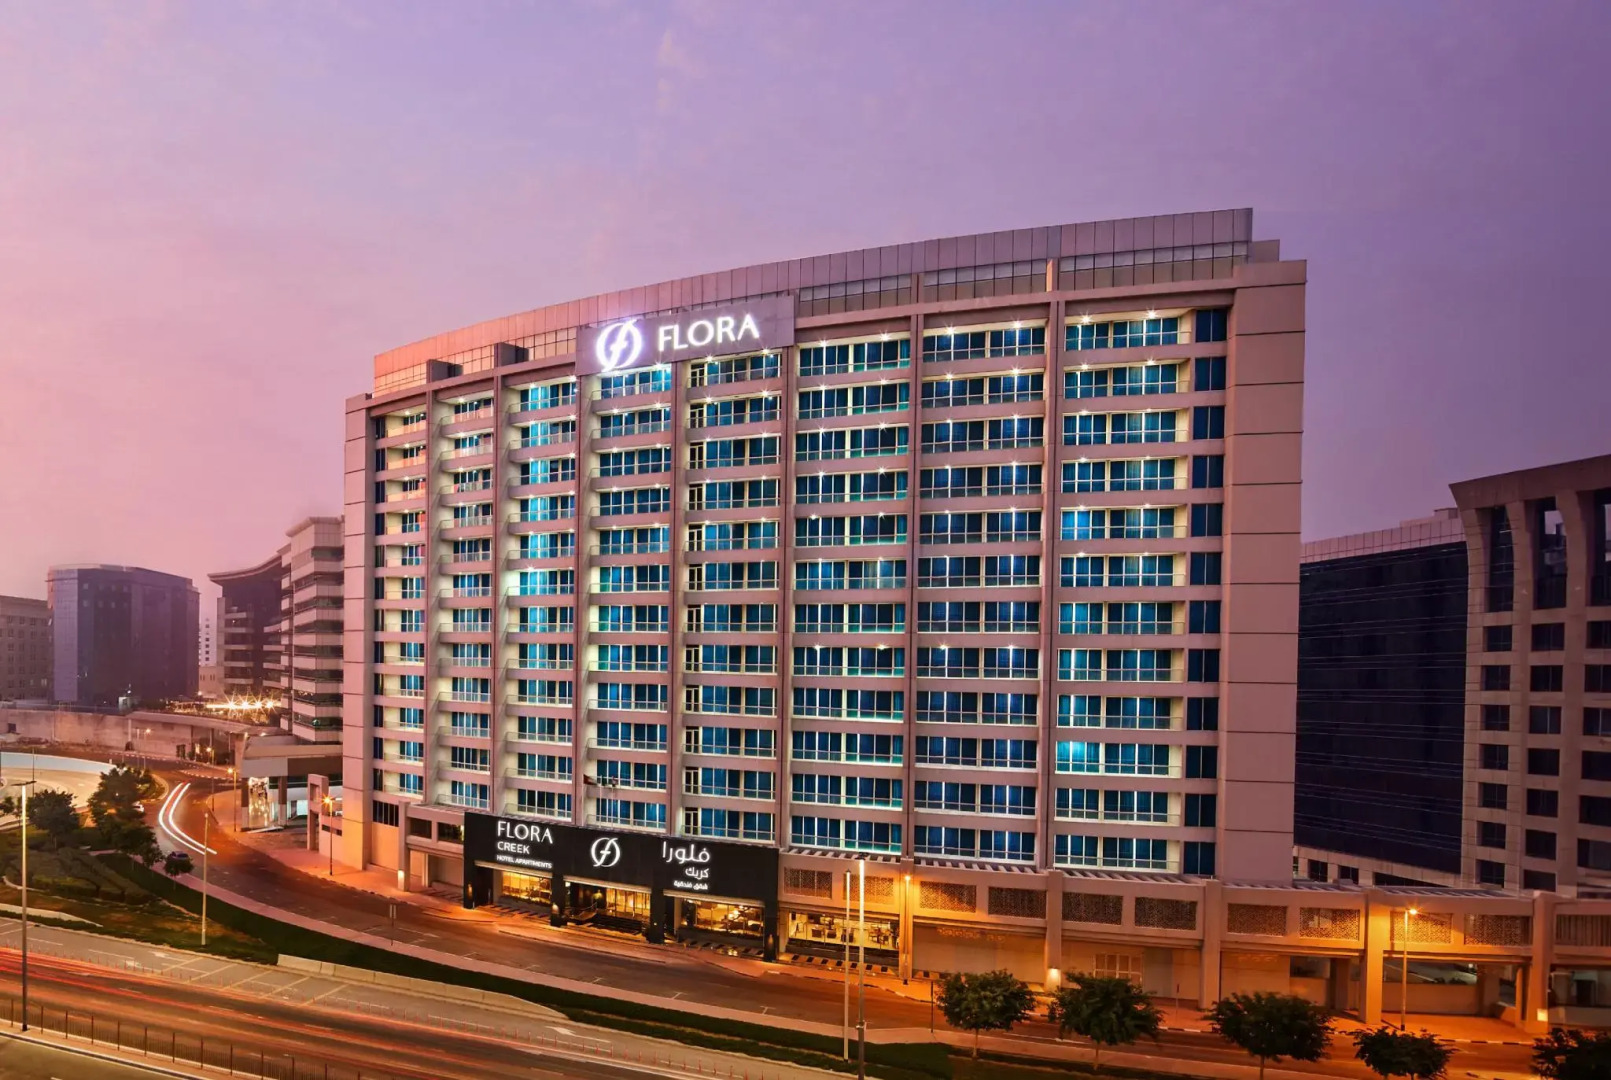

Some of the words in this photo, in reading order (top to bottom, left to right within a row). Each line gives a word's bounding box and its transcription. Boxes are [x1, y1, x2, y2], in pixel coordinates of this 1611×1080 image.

[658, 313, 760, 352] FLORA
[497, 820, 553, 844] FLORA
[497, 841, 530, 854] CREEK
[662, 841, 710, 864] فلورا
[496, 855, 514, 863] HOTEL
[515, 858, 552, 868] APARTMENTS
[685, 866, 709, 880] كريك
